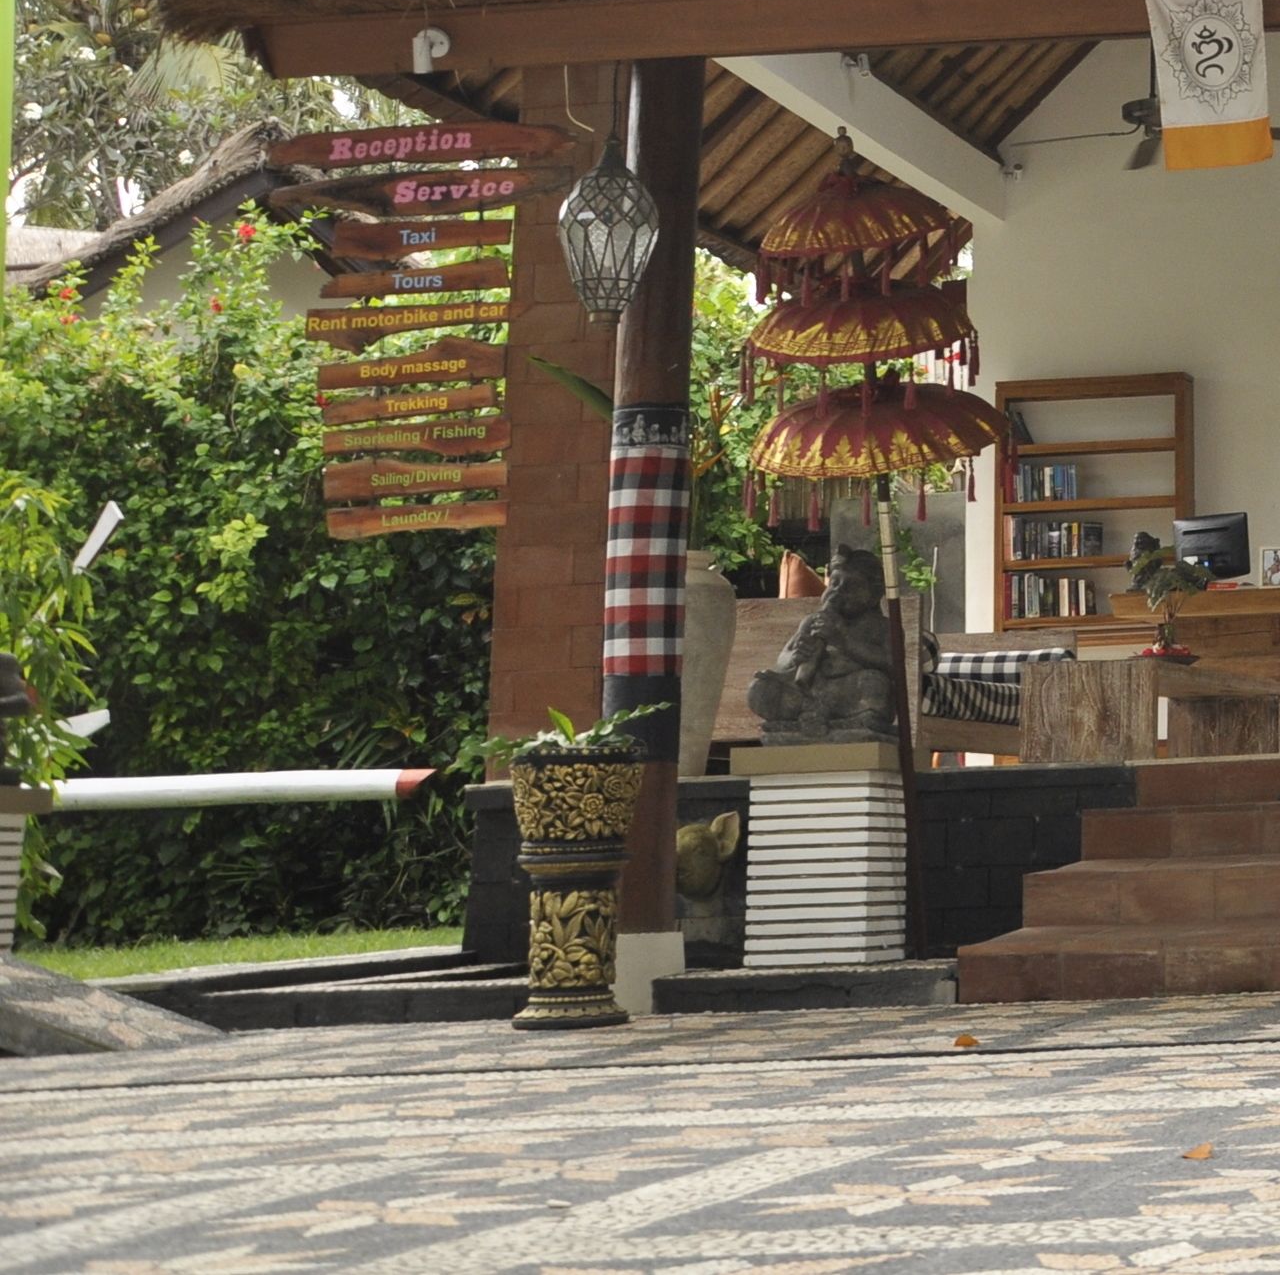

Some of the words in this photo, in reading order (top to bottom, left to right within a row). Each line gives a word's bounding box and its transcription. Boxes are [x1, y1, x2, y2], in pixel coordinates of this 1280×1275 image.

[329, 129, 472, 161] Reception
[394, 179, 514, 203] Service
[400, 227, 436, 245] Taxi
[392, 274, 443, 289] Tours
[308, 315, 347, 331] Rent
[444, 304, 475, 321] and
[479, 303, 507, 317] car
[360, 364, 398, 379] Body
[402, 358, 467, 373] massage
[386, 396, 448, 412] Trekking
[344, 430, 421, 448] Snorkeling
[433, 426, 487, 440] Fishing
[382, 509, 442, 527] Laundry
